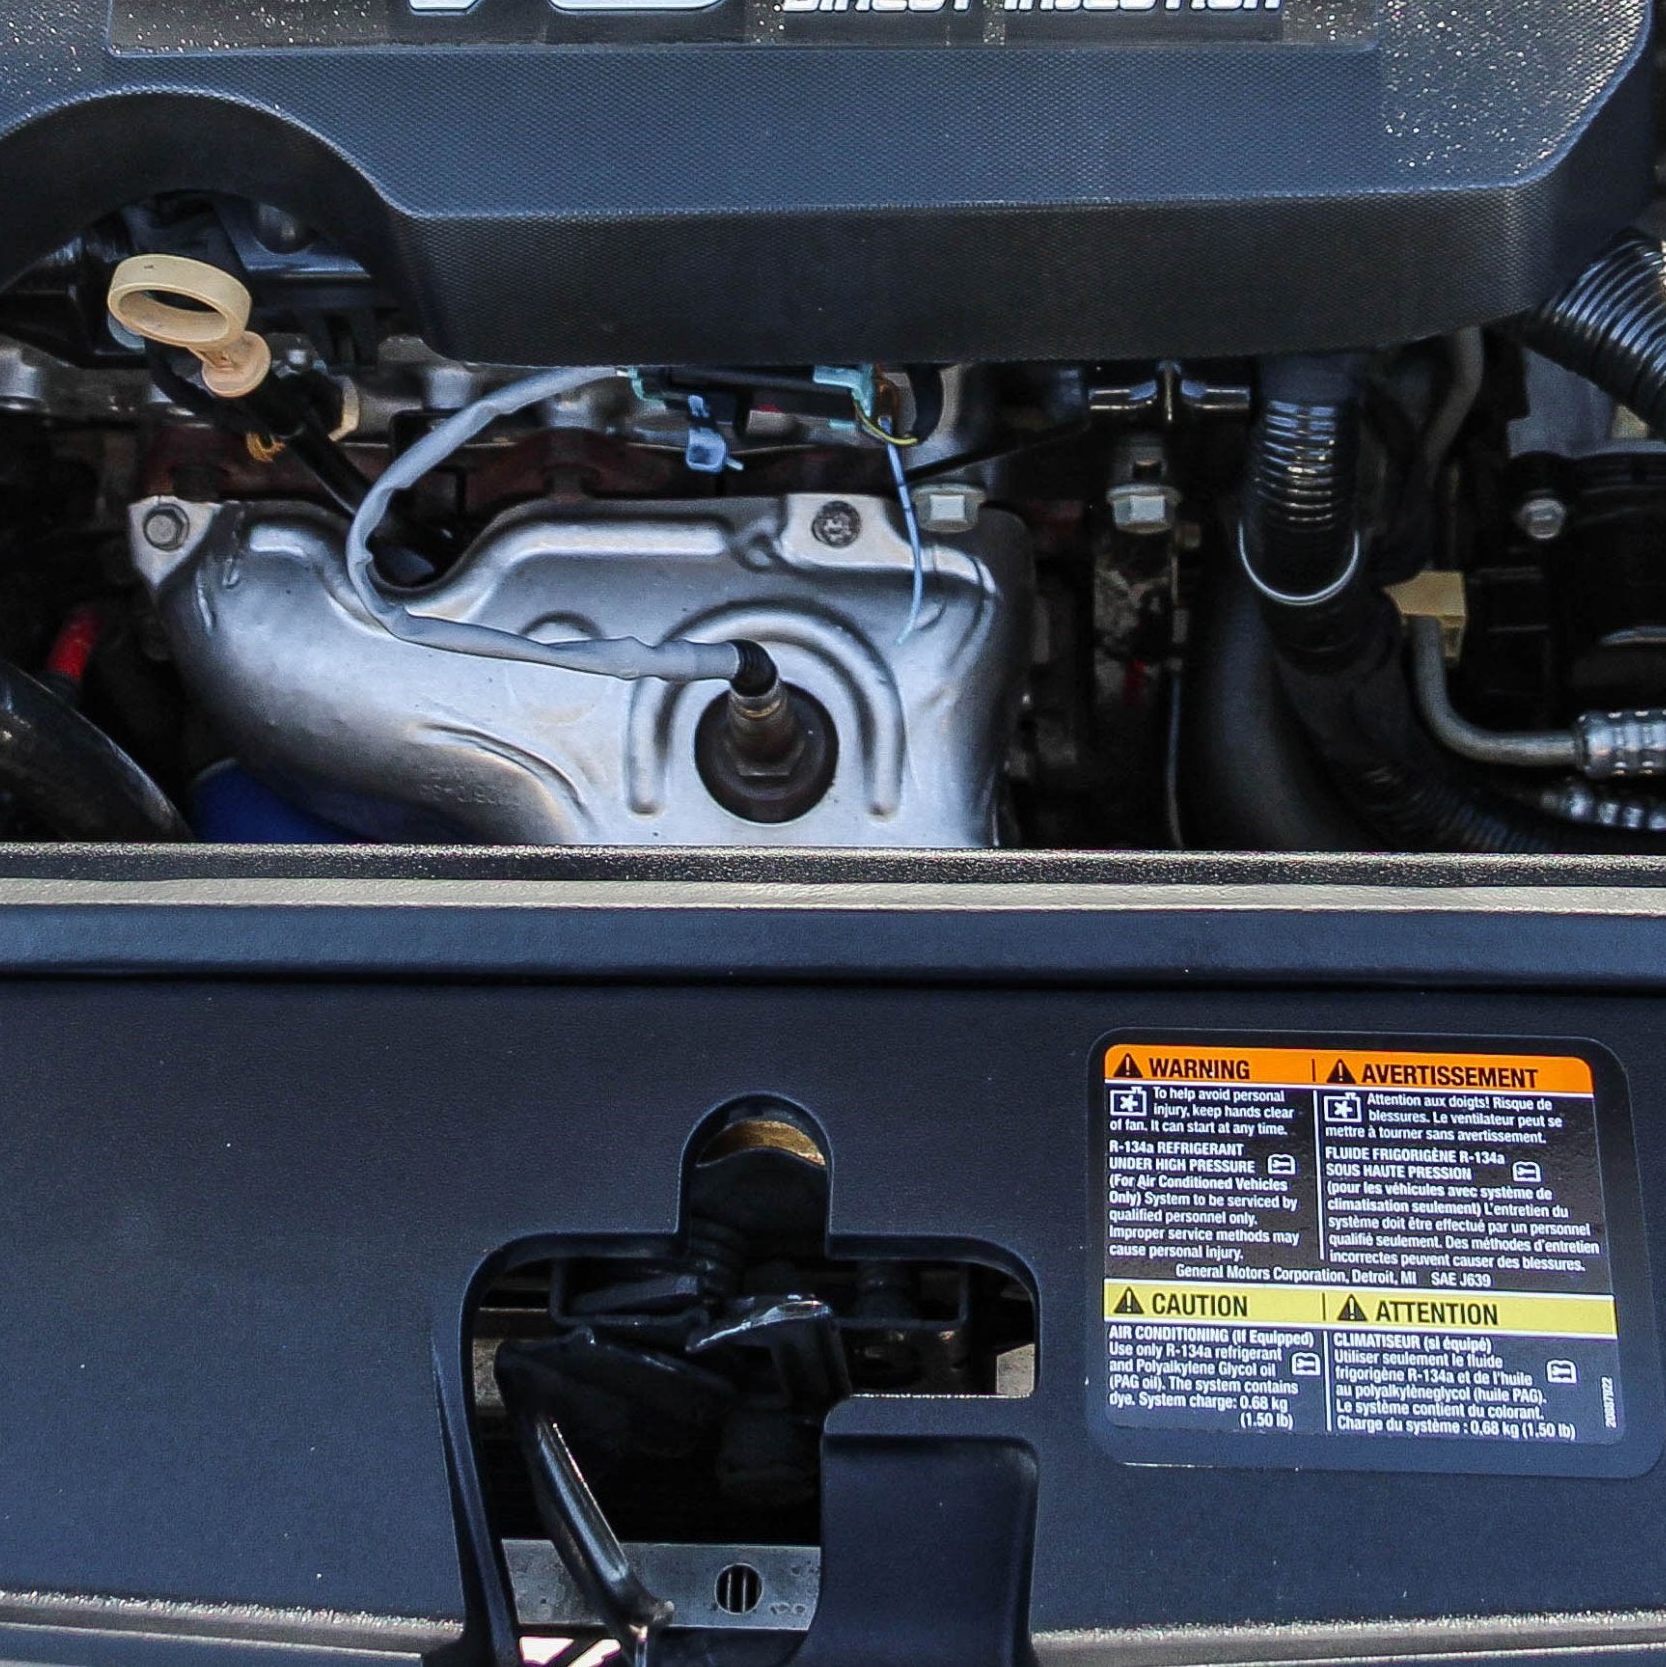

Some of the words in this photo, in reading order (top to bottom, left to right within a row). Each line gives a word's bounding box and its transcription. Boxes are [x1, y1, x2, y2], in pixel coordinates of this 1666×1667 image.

[1148, 1058, 1249, 1078] WARNING
[1361, 1066, 1538, 1087] AVERTISSEMENT
[1153, 1085, 1167, 1098] To
[1169, 1085, 1195, 1102] help
[1198, 1086, 1230, 1100] avoid
[1232, 1087, 1284, 1104] personal
[1366, 1092, 1421, 1106] Attention
[1423, 1097, 1446, 1107] aux
[1448, 1093, 1490, 1111] doigts!
[1492, 1094, 1534, 1112] Risque
[1536, 1095, 1552, 1109] de
[1153, 1101, 1190, 1118] injury,
[1192, 1102, 1222, 1119] keep
[1224, 1103, 1261, 1117] hands
[1263, 1104, 1294, 1118] clear
[1368, 1107, 1430, 1123] blessures.
[1432, 1109, 1448, 1123] Le
[1450, 1110, 1514, 1125] ventilateur
[1517, 1113, 1545, 1129] peut
[1547, 1117, 1562, 1127] se
[1109, 1117, 1122, 1130] of
[1124, 1117, 1147, 1131] fan.
[1150, 1118, 1159, 1131] It
[1161, 1121, 1184, 1132] can
[1186, 1119, 1215, 1133] start
[1217, 1120, 1230, 1133] at
[1232, 1123, 1254, 1137] any
[1257, 1120, 1287, 1134] time.
[1325, 1124, 1365, 1138] mettre
[1367, 1124, 1376, 1138] à
[1378, 1126, 1423, 1139] tourner
[1425, 1129, 1454, 1140] sans
[1457, 1127, 1546, 1142] avertissement.
[1109, 1140, 1154, 1153] R-134a
[1157, 1141, 1244, 1155] REFRIGERANT
[1325, 1146, 1370, 1160] FLUIDE
[1372, 1145, 1456, 1162] FRIGORIGÈNE
[1459, 1149, 1505, 1164] R-134a
[1109, 1157, 1152, 1170] UNDER
[1155, 1157, 1186, 1171] HIGH
[1189, 1158, 1255, 1172] PRESSURE
[1325, 1163, 1360, 1177] SOUS
[1363, 1164, 1405, 1178] HAUTE
[1407, 1165, 1471, 1179] PRESSION
[1109, 1173, 1135, 1189] (For
[1136, 1174, 1156, 1187] Air
[1158, 1174, 1232, 1189] Conditioned
[1235, 1176, 1287, 1190] Vehicles
[1327, 1180, 1360, 1197] (pour
[1363, 1180, 1382, 1194] les
[1384, 1181, 1445, 1196] véhicules
[1447, 1186, 1477, 1197] avec
[1479, 1184, 1533, 1201] système
[1535, 1185, 1552, 1199] de
[1109, 1190, 1141, 1207] Only)
[1144, 1191, 1190, 1208] System
[1193, 1193, 1205, 1206] to
[1208, 1192, 1224, 1206] be
[1227, 1193, 1279, 1207] serviced
[1282, 1194, 1297, 1211] by
[1327, 1197, 1409, 1212] climatisation
[1411, 1199, 1481, 1216] seulement)
[1551, 1202, 1568, 1216] du
[1109, 1207, 1162, 1224] qualified
[1165, 1208, 1226, 1226] personnel
[1229, 1209, 1257, 1226] only.
[1328, 1215, 1379, 1232] système
[1381, 1216, 1405, 1230] doit
[1407, 1216, 1432, 1230] être
[1435, 1217, 1485, 1231] effectué
[1487, 1222, 1508, 1235] par
[1510, 1222, 1527, 1232] un
[1529, 1219, 1590, 1237] personnel
[1109, 1224, 1165, 1242] Improper
[1168, 1226, 1213, 1240] service
[1216, 1227, 1270, 1241] methods
[1272, 1231, 1299, 1245] may
[1375, 1233, 1442, 1248] seulement.
[1445, 1235, 1469, 1249] Des
[1471, 1236, 1531, 1251] méthodes
[1109, 1245, 1146, 1256] cause
[1149, 1243, 1202, 1260] personal
[1205, 1244, 1243, 1261] injury.
[1329, 1249, 1398, 1265] incorrectes
[1400, 1252, 1450, 1269] peuvent
[1452, 1256, 1494, 1267] causer
[1497, 1254, 1520, 1268] des
[1522, 1255, 1585, 1270] blessures.
[1175, 1263, 1223, 1279] General
[1226, 1264, 1270, 1280] Motors
[1272, 1265, 1349, 1285] Corporation,
[1351, 1267, 1398, 1285] Detroit,
[1400, 1268, 1416, 1283] MI
[1430, 1269, 1456, 1284] SAE
[1459, 1270, 1491, 1285] J639
[1152, 1293, 1247, 1316] CAUTION
[1375, 1301, 1497, 1324] ATTENTION
[1108, 1324, 1132, 1339] AIR
[1134, 1325, 1229, 1342] CONDITIONING
[1232, 1328, 1246, 1345] (If
[1249, 1329, 1313, 1348] Equipped)
[1333, 1333, 1420, 1349] CLIMATISEUR
[1423, 1335, 1440, 1352] (si
[1442, 1336, 1491, 1354] équipé)
[1109, 1341, 1133, 1356] Use
[1135, 1341, 1163, 1359] only
[1166, 1342, 1212, 1358] R-134a
[1214, 1344, 1282, 1363] refrigerant
[1334, 1349, 1379, 1364] Utiliser
[1382, 1350, 1449, 1365] seulement
[1451, 1351, 1463, 1366] le
[1466, 1351, 1502, 1366] fluide
[1109, 1357, 1133, 1372] and
[1136, 1358, 1215, 1377] Polyalkylene
[1218, 1360, 1257, 1378] Glycol
[1259, 1361, 1275, 1376] oil
[1335, 1365, 1404, 1384] frigorigène
[1407, 1367, 1454, 1383] R-134a
[1457, 1370, 1471, 1384] et
[1473, 1369, 1490, 1384] de
[1109, 1374, 1139, 1391] (PAG
[1142, 1375, 1166, 1392] oil).
[1170, 1375, 1192, 1390] The
[1195, 1377, 1241, 1395] system
[1243, 1377, 1298, 1393] contains
[1335, 1384, 1352, 1396] au
[1354, 1382, 1470, 1403] polyalkylèneglycol
[1473, 1386, 1509, 1403] (huile
[1512, 1387, 1546, 1405] PAG).
[1109, 1390, 1135, 1408] dye.
[1138, 1391, 1186, 1410] System
[1189, 1393, 1237, 1411] charge:
[1239, 1394, 1268, 1409] 0.68
[1271, 1395, 1287, 1413] kg
[1336, 1398, 1352, 1413] Le
[1355, 1399, 1409, 1418] système
[1412, 1401, 1465, 1416] contient
[1467, 1402, 1484, 1417] du
[1487, 1403, 1544, 1419] colorant.
[1240, 1412, 1273, 1429] (1.50
[1276, 1413, 1293, 1429] lb)
[1337, 1415, 1383, 1433] Charge
[1385, 1416, 1402, 1431] du
[1405, 1417, 1460, 1436] système
[1502, 1420, 1519, 1438] kg
[1558, 1422, 1575, 1439] lb)
